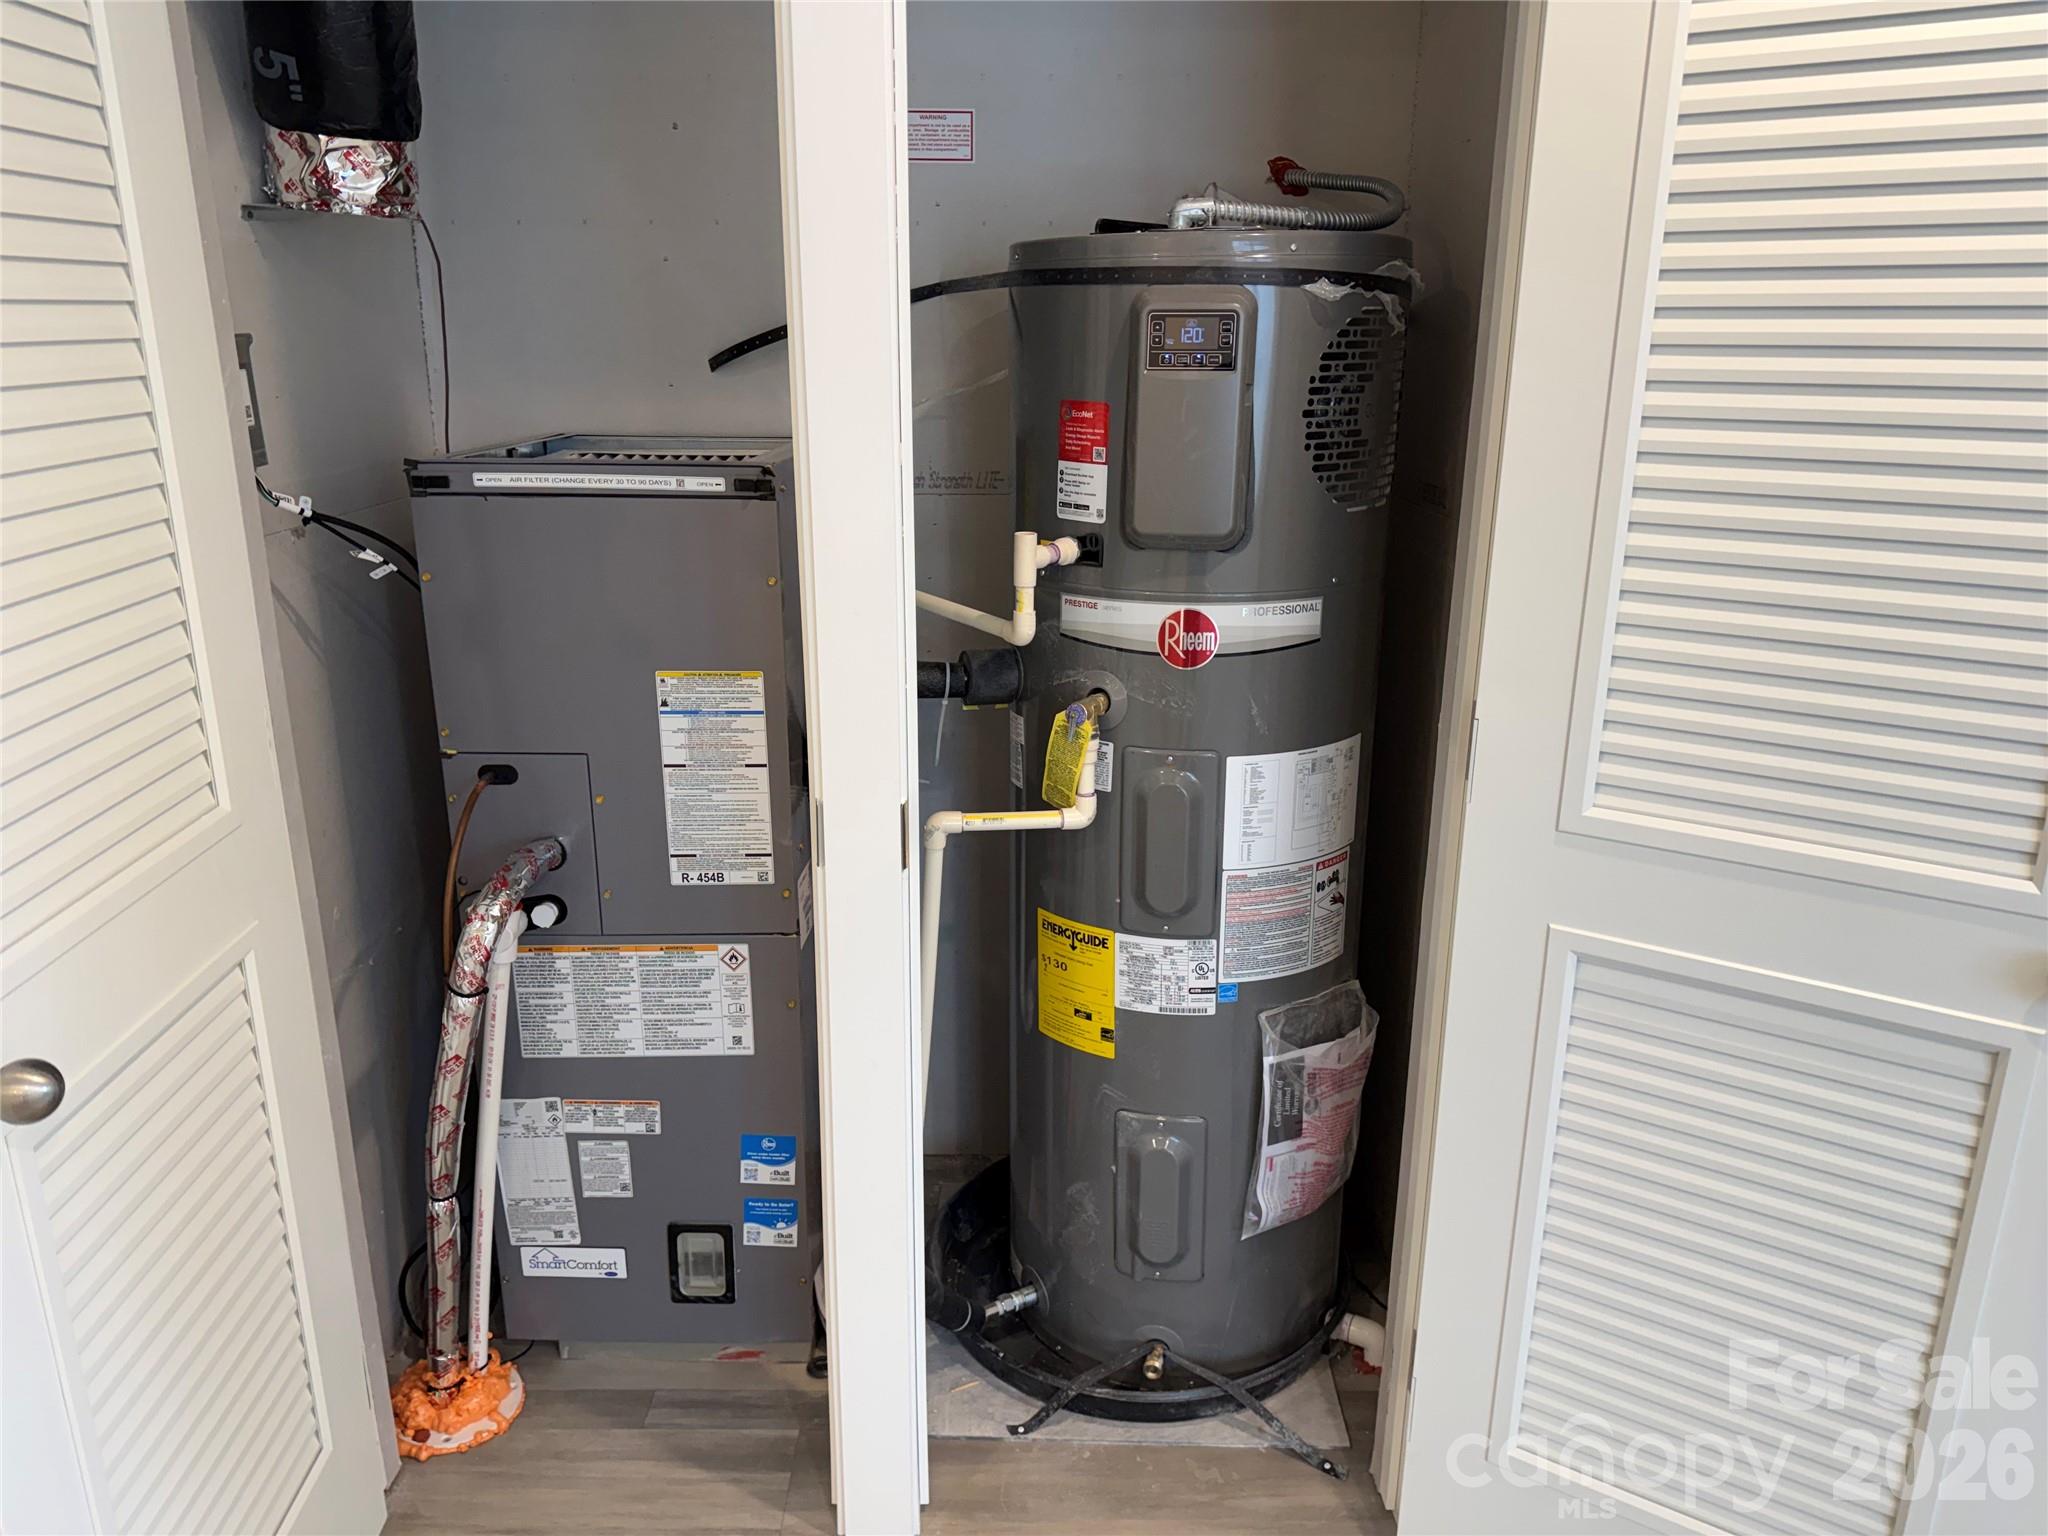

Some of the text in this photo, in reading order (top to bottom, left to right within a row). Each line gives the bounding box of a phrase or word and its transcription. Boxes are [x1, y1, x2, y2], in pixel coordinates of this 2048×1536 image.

[1072, 409, 1093, 418] EcoNet
[551, 477, 585, 485] (CHANGE
[1064, 598, 1099, 610] PRESTIGE
[1164, 607, 1216, 660] Rheem
[681, 872, 725, 883] R- 454B
[1042, 918, 1109, 950] ENERGYGUIDE
[529, 1257, 618, 1270] SmartComfort
